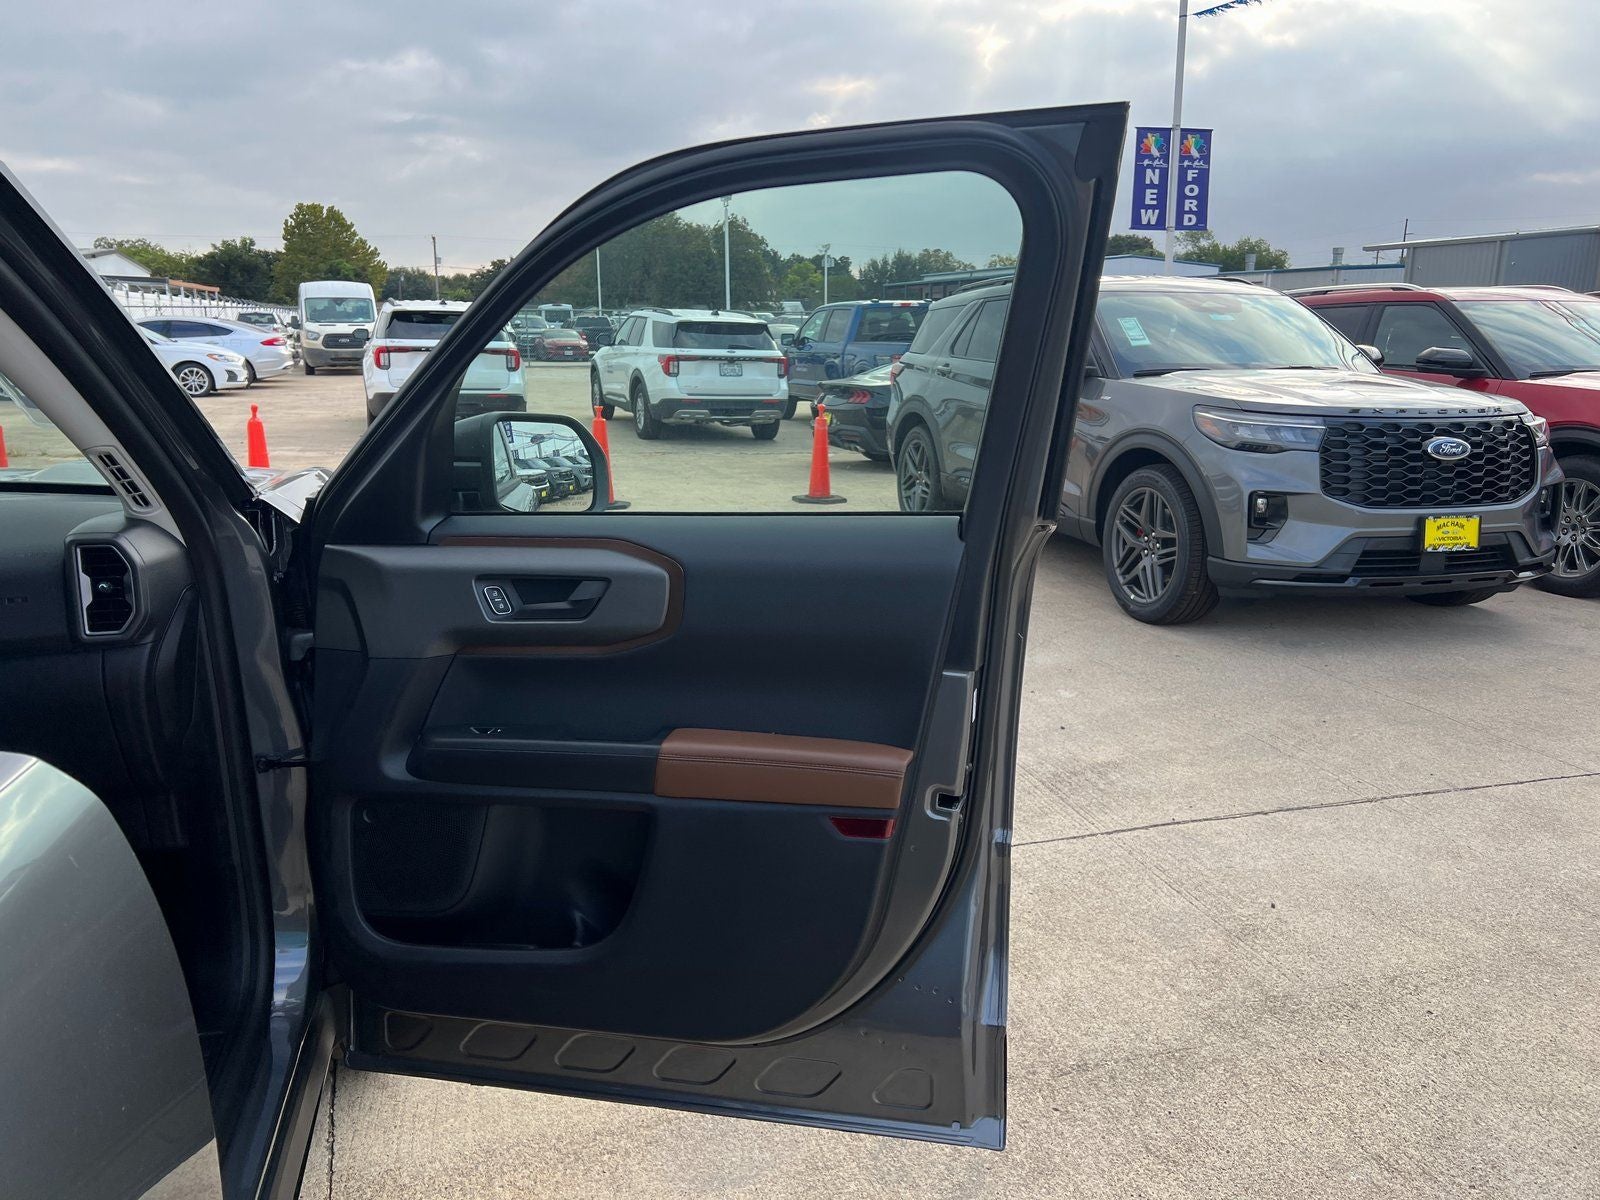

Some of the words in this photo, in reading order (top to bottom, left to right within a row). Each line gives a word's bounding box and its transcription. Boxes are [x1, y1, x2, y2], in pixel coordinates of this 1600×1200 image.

[1141, 169, 1160, 225] NEW
[1183, 170, 1199, 226] FORD
[1440, 443, 1463, 454] Ford
[1436, 521, 1450, 531] MAC
